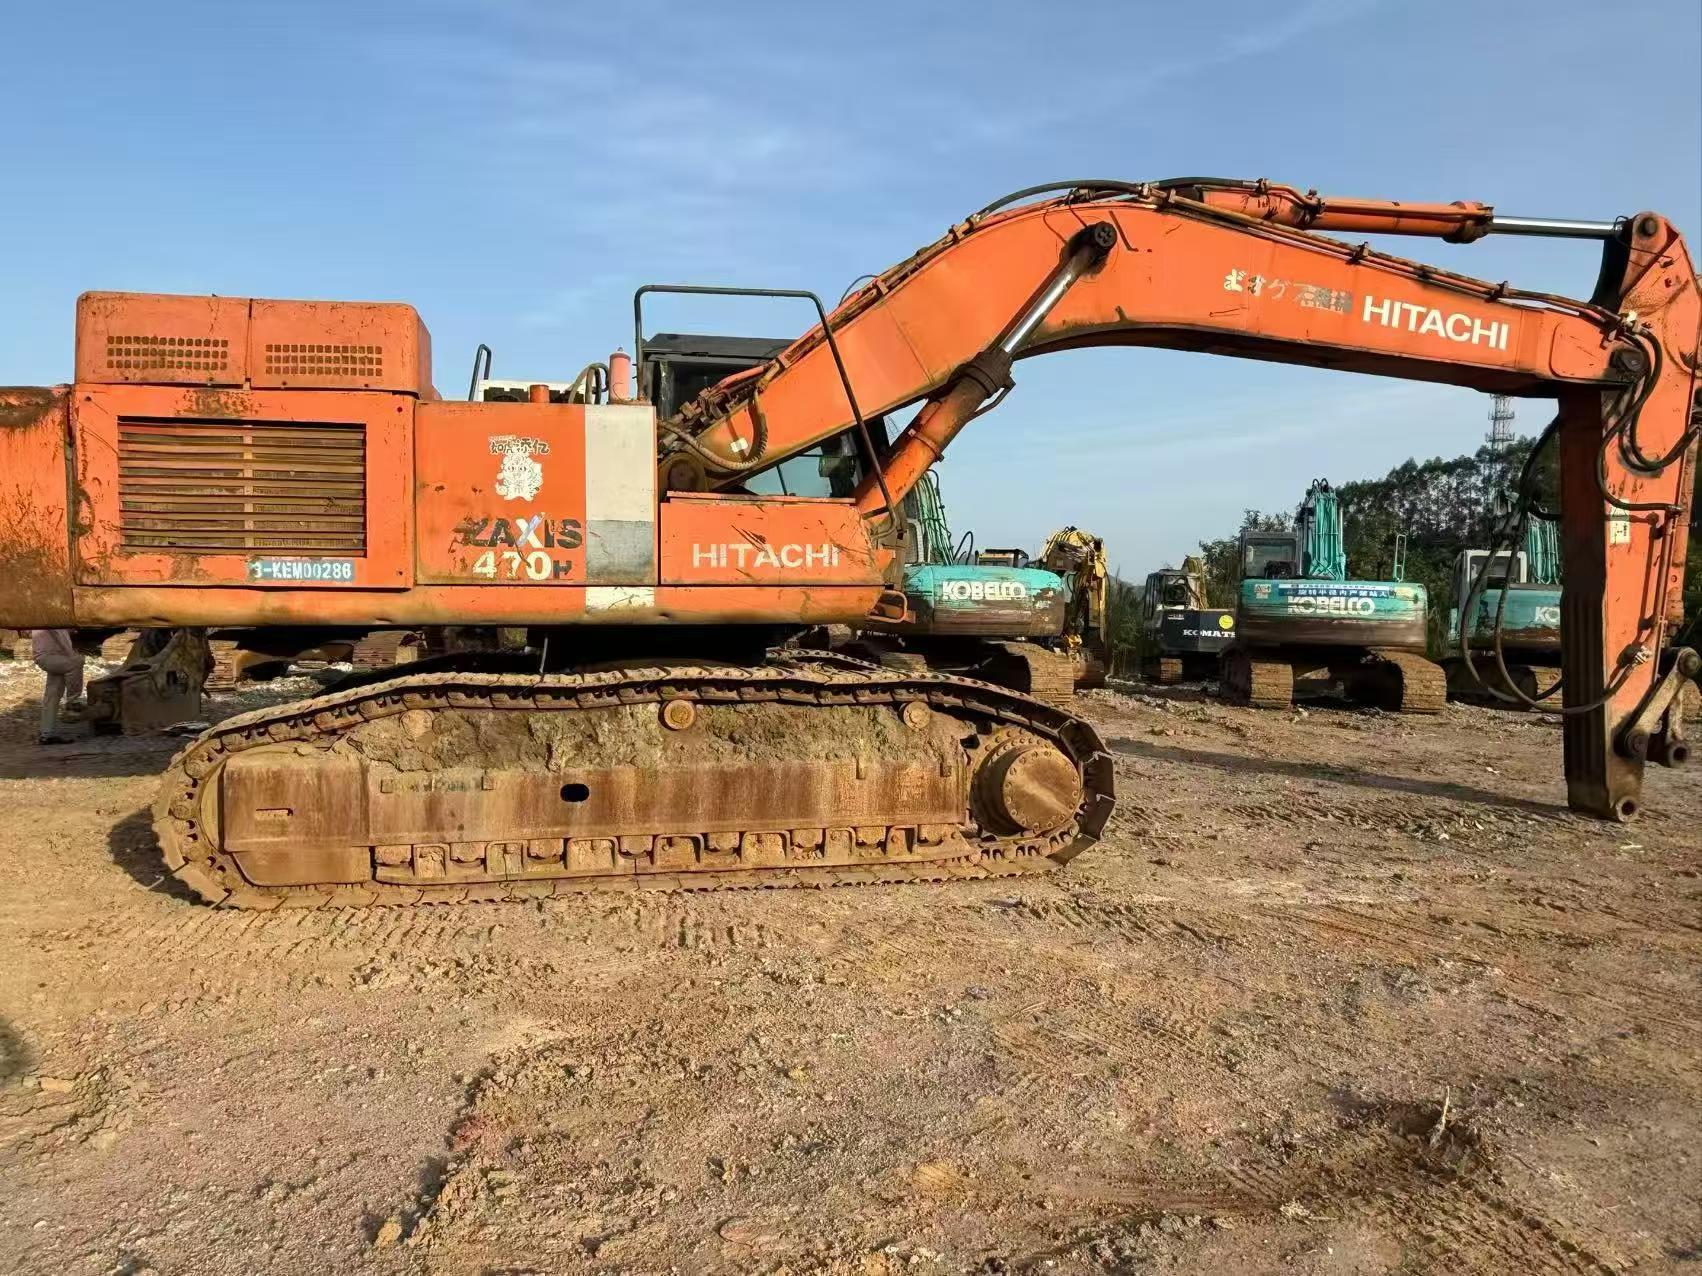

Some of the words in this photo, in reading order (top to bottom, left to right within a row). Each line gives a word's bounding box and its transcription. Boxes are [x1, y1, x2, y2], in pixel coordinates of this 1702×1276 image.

[1362, 295, 1510, 350] HITACHI
[462, 516, 583, 549] ZAXIS
[692, 543, 840, 569] HITACHI
[942, 581, 1026, 600] KOBELCO
[1287, 596, 1375, 616] KOBELCO
